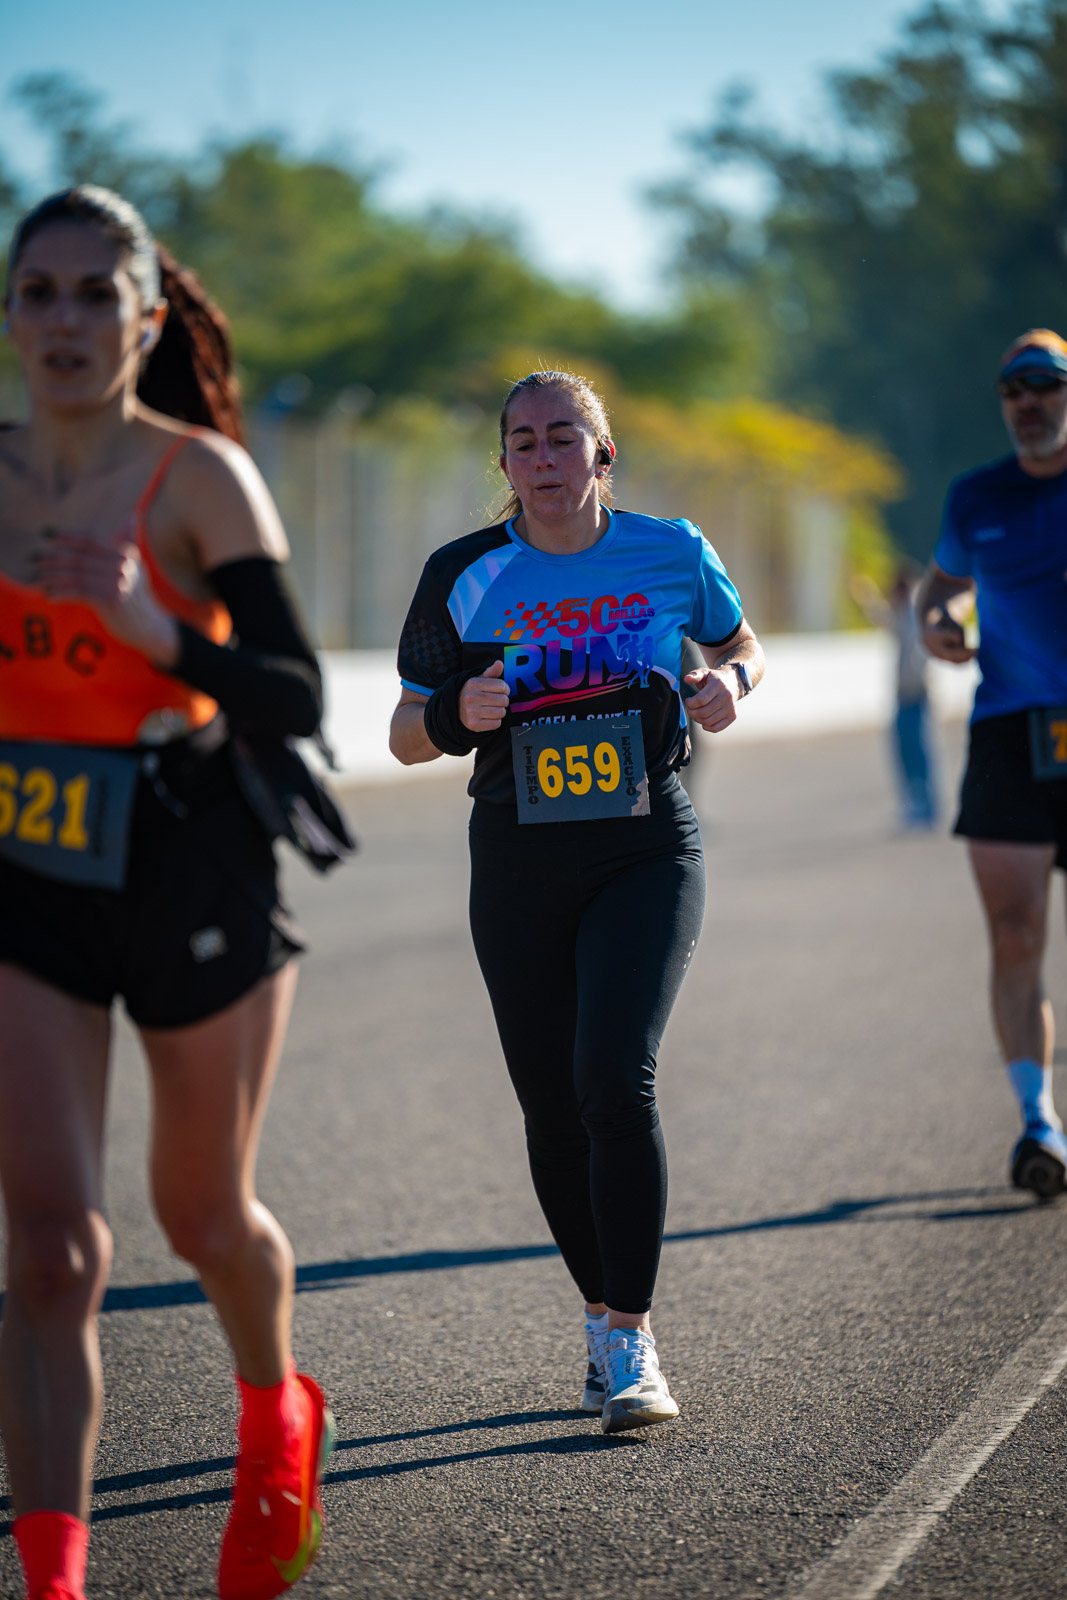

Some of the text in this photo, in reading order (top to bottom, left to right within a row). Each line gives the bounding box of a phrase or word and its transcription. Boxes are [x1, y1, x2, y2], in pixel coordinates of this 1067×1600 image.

[557, 593, 650, 637] 500
[609, 608, 655, 621] MILLAS
[0, 614, 105, 676] BC
[503, 634, 637, 697] RUN
[523, 746, 539, 805] TIEMPO
[537, 742, 621, 798] 659
[621, 736, 637, 796] EXACTO
